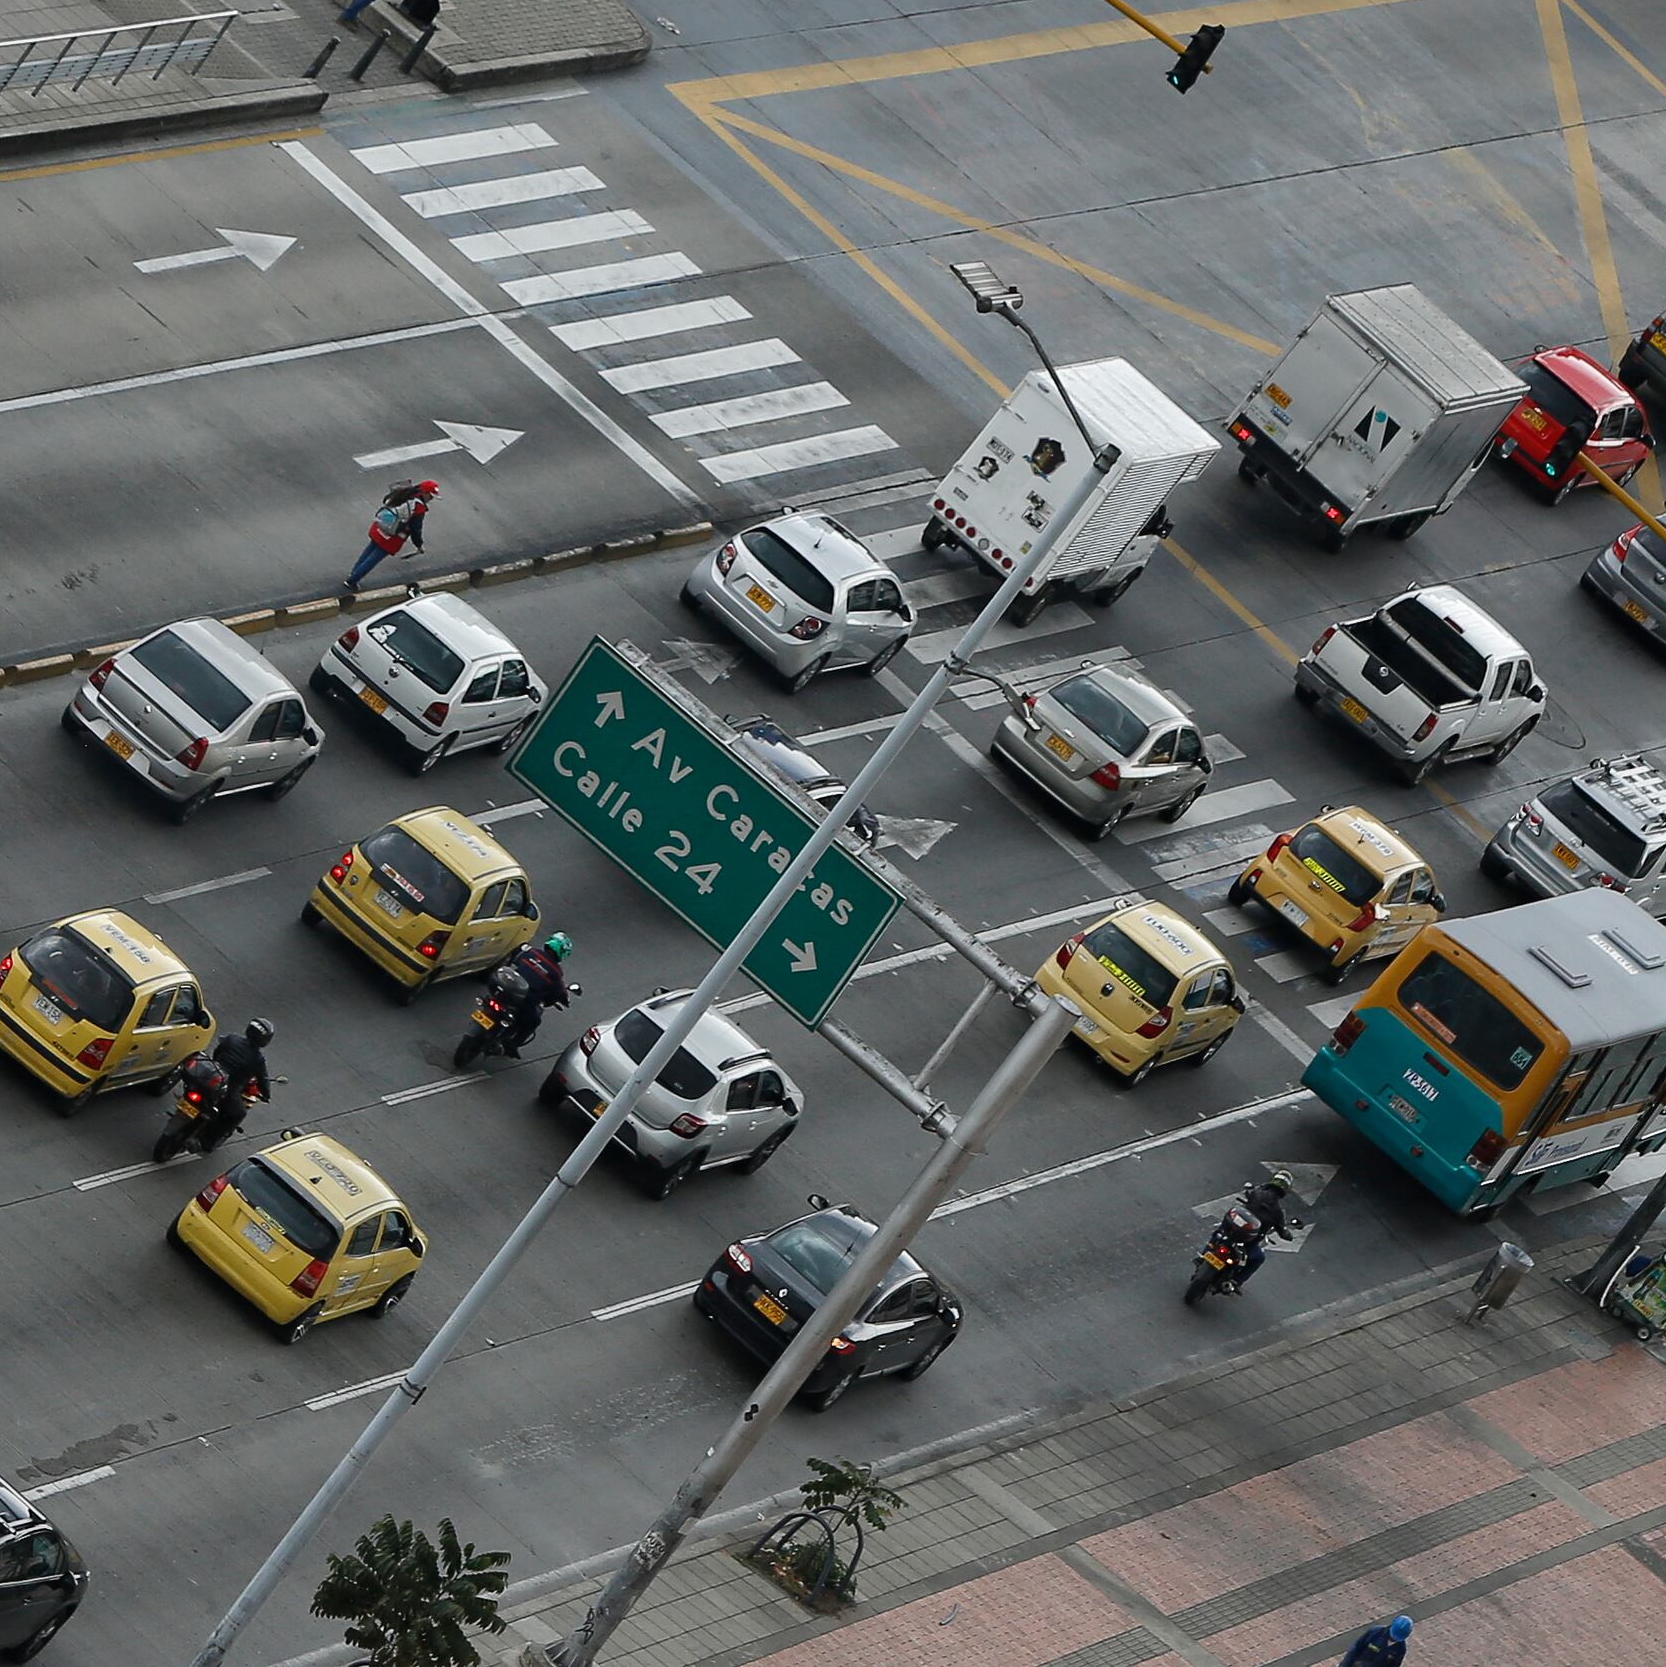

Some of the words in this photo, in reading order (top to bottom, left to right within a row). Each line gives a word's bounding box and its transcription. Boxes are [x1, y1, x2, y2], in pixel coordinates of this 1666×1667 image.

[631, 728, 693, 785] Av
[553, 740, 644, 833] Calle
[654, 829, 722, 896] 24
